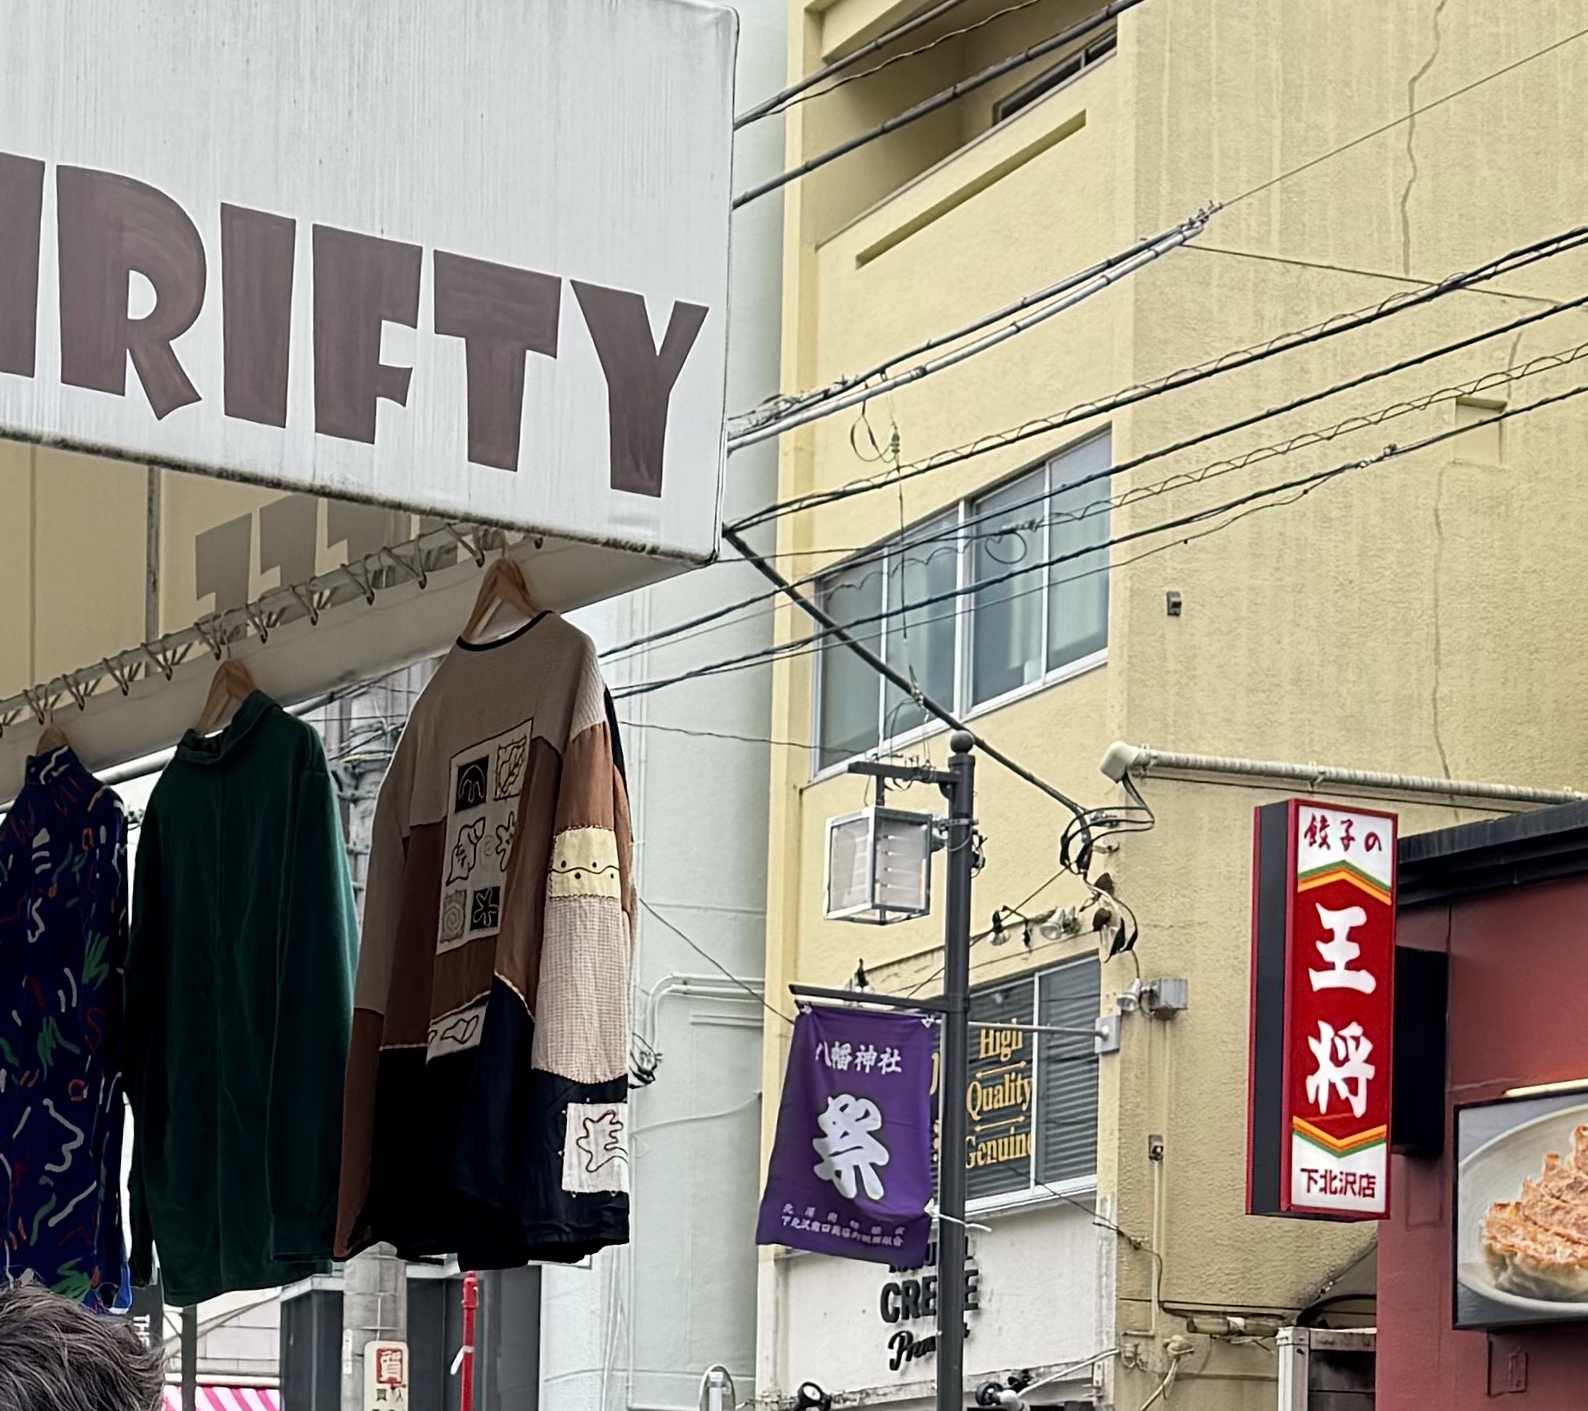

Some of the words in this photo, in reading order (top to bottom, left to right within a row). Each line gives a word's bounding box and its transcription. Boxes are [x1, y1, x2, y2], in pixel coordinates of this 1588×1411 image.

[1304, 814, 1382, 852] 餃子の
[1305, 902, 1377, 1119] 王将
[815, 1041, 902, 1075] 八幡神社
[978, 1018, 1023, 1061] High
[966, 1072, 1032, 1120] Quality
[812, 1093, 890, 1200] 祭
[1300, 1167, 1376, 1199] 下北沢店
[880, 1269, 979, 1324] CREE
